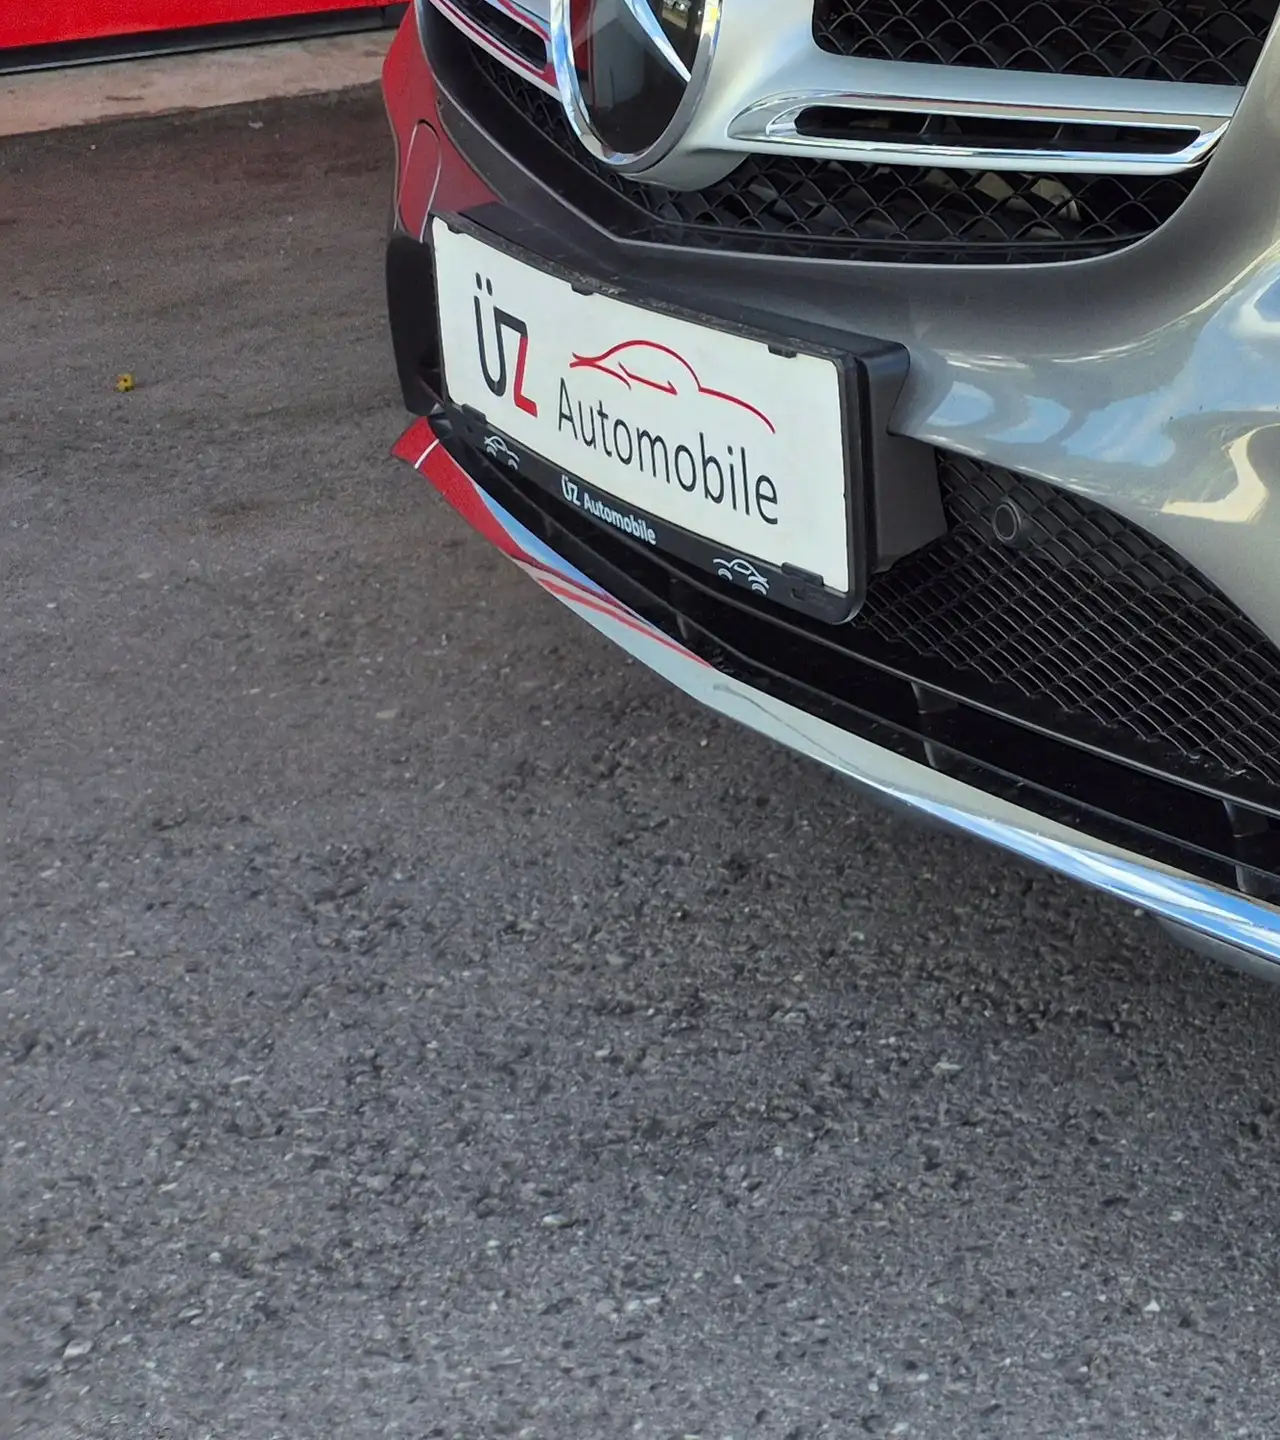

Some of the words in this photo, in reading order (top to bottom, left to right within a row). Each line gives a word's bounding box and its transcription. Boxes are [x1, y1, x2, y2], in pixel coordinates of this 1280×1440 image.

[474, 272, 538, 418] ÜZ
[557, 376, 779, 525] Automobile
[561, 474, 581, 506] ÜZ
[583, 492, 657, 546] Automobile
